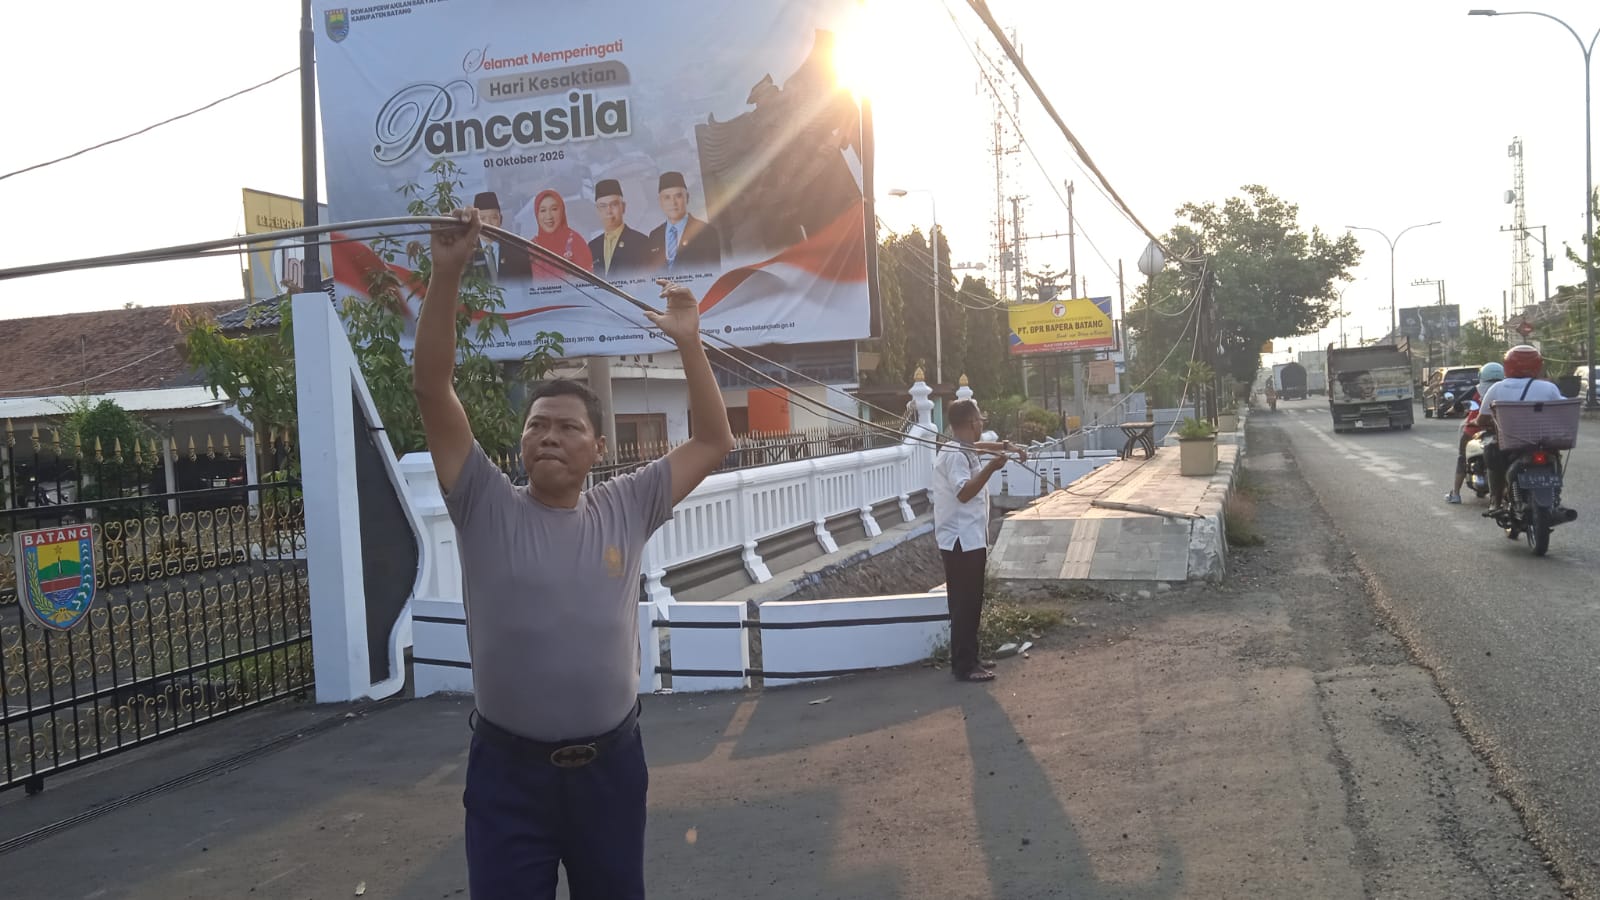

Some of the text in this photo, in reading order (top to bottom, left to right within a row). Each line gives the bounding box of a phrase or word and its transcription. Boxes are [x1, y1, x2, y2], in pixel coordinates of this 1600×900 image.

[463, 39, 623, 74] Selamat Memperingati
[489, 67, 616, 97] Hari Kesaktian
[373, 79, 628, 162] Pancasila
[483, 150, 565, 168] 01 Oktober 2026
[1075, 319, 1103, 329] BATANG
[24, 528, 88, 545] BATANG
